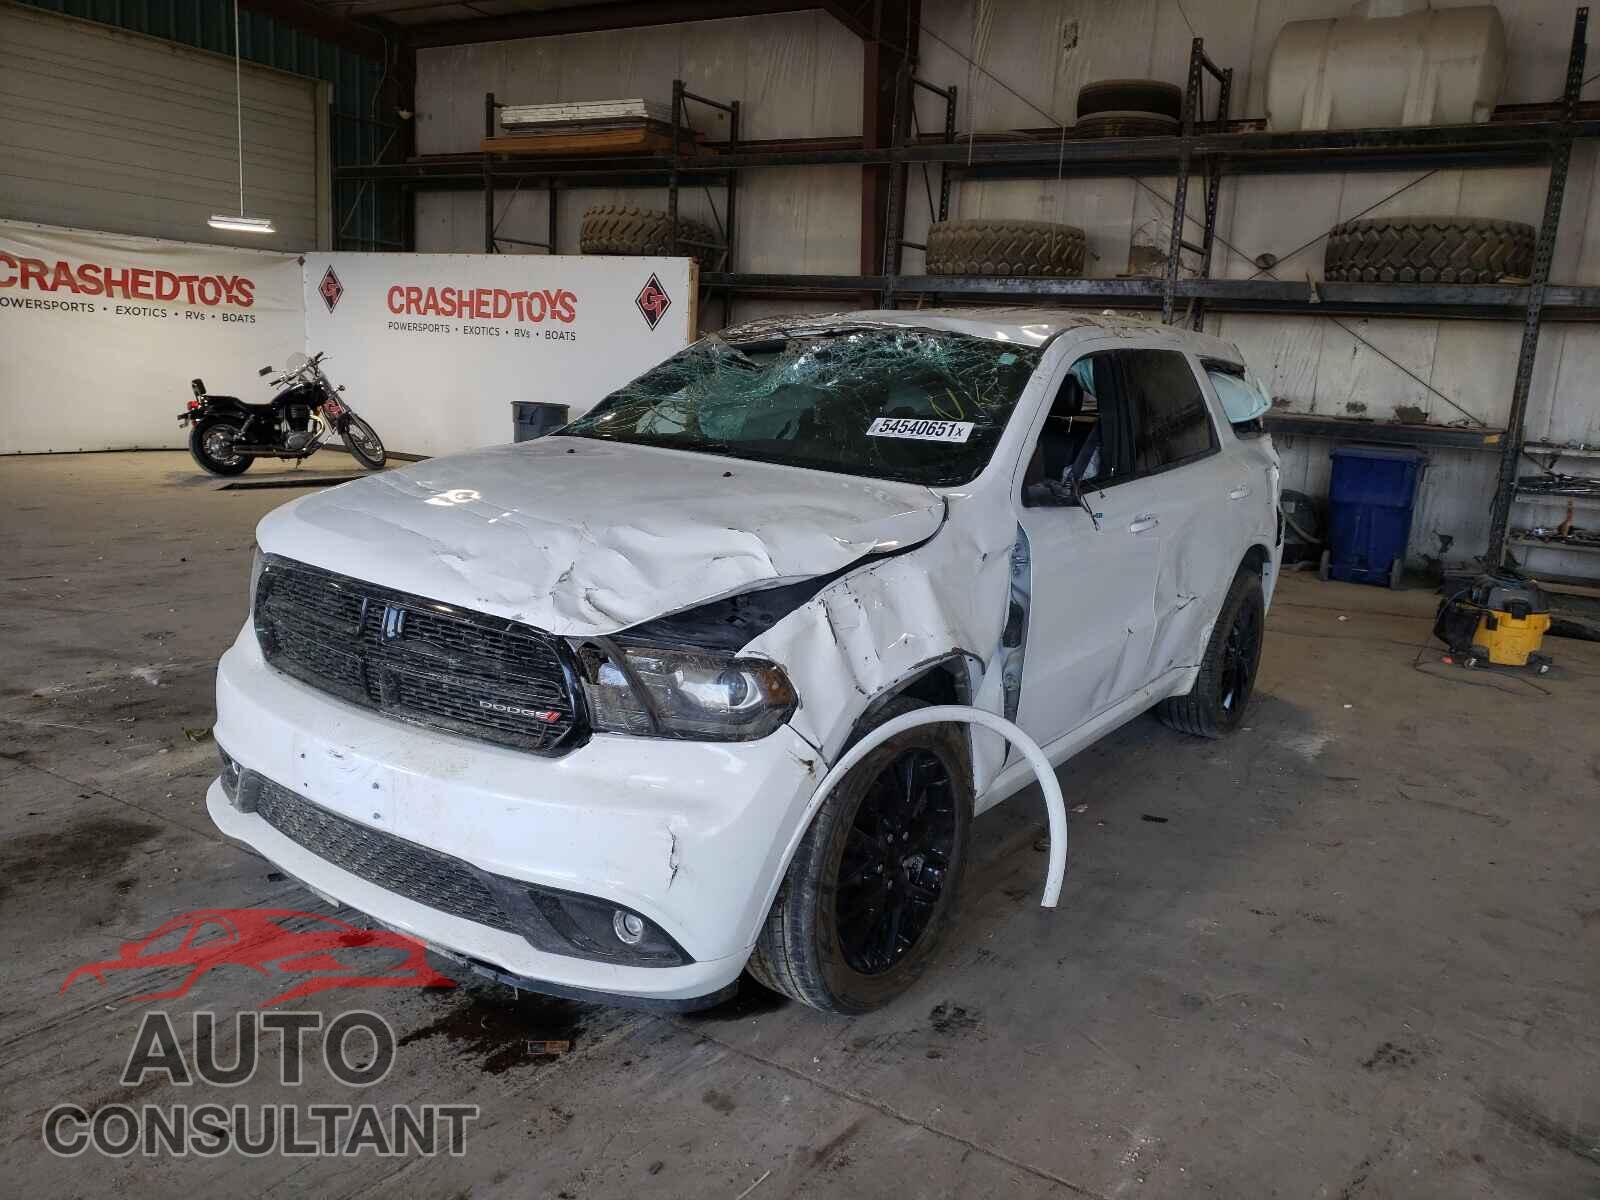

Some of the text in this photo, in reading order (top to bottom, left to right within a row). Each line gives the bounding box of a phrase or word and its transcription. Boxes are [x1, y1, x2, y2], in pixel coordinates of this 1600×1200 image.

[0, 252, 256, 308] CRASHEDTOYS
[0, 296, 256, 324] OWERSPORTS EXOTICS RVs BOATS
[387, 285, 578, 323] CRASHEDTOYS
[388, 321, 577, 341] POWERSPORTS EXOTICS RVs BOATS
[479, 700, 549, 719] DODGE
